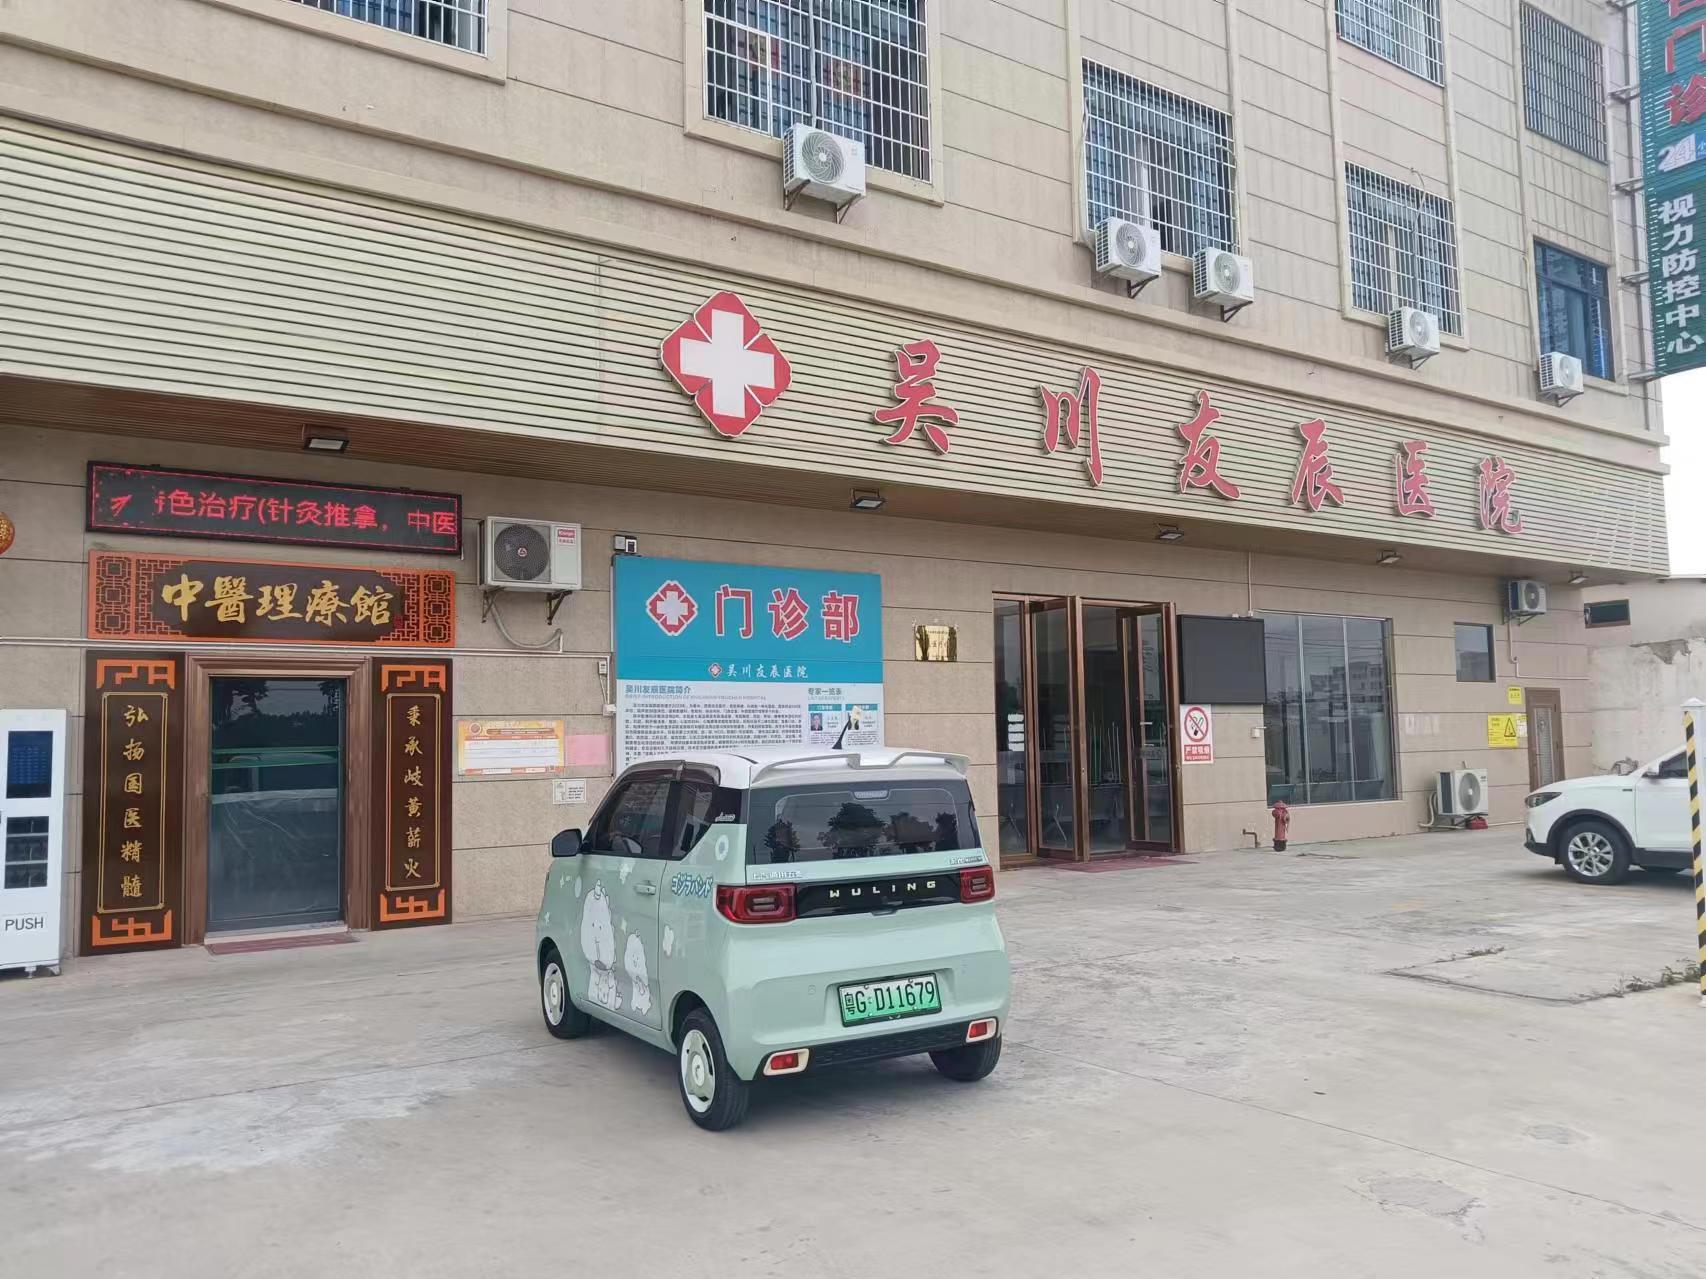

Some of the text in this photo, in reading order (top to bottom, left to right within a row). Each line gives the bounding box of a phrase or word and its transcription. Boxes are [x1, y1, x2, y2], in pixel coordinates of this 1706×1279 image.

[1658, 192, 1704, 354] 视力防控中心
[872, 338, 1523, 534] 吴川友辰医院
[161, 573, 394, 627] 中醫理療館
[714, 583, 860, 643] 门诊部
[727, 664, 808, 678] 吴川友辰医院
[120, 705, 149, 899] 弘扬国医精髓
[829, 881, 937, 898] WULING
[5, 917, 44, 931] PUSH
